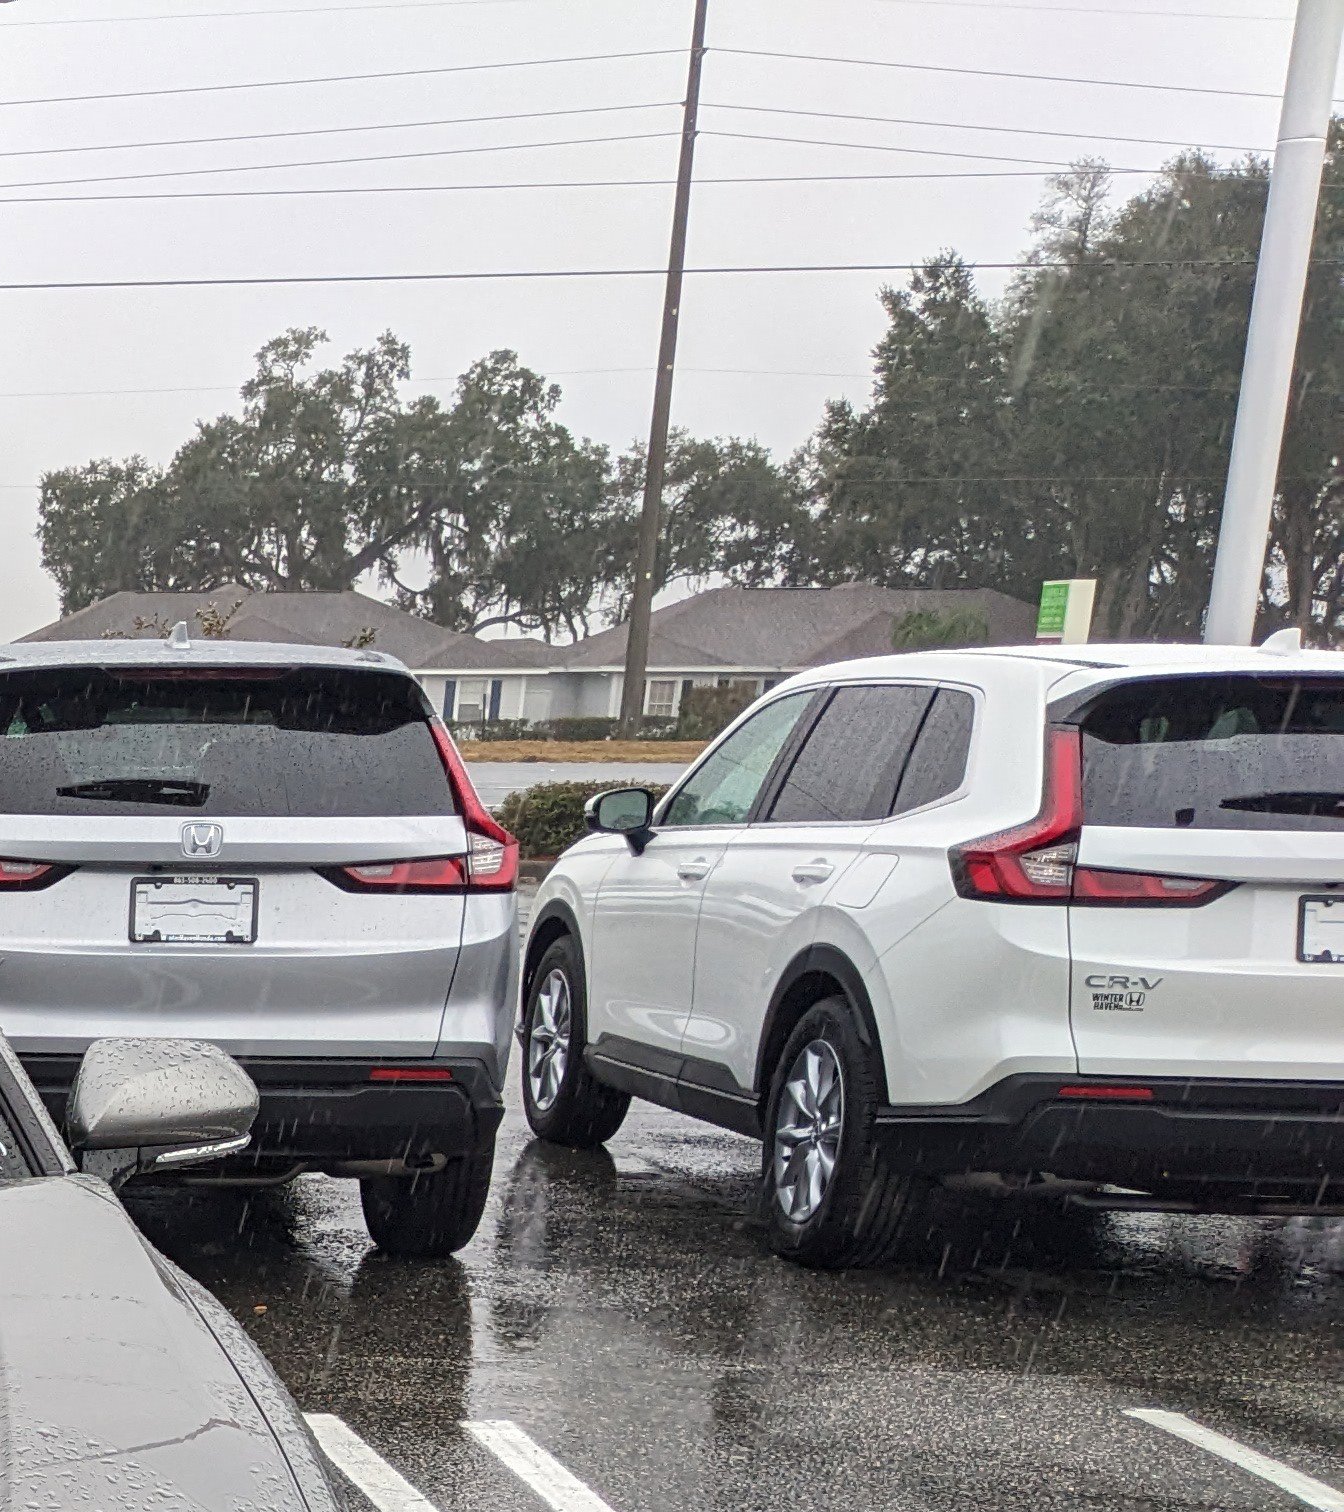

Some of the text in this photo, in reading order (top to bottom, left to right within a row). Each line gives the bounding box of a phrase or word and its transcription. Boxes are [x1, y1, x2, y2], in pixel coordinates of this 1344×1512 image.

[1085, 975, 1164, 990] CR-V
[1092, 993, 1124, 1002] WINTER
[1093, 1002, 1119, 1010] HAVEN
